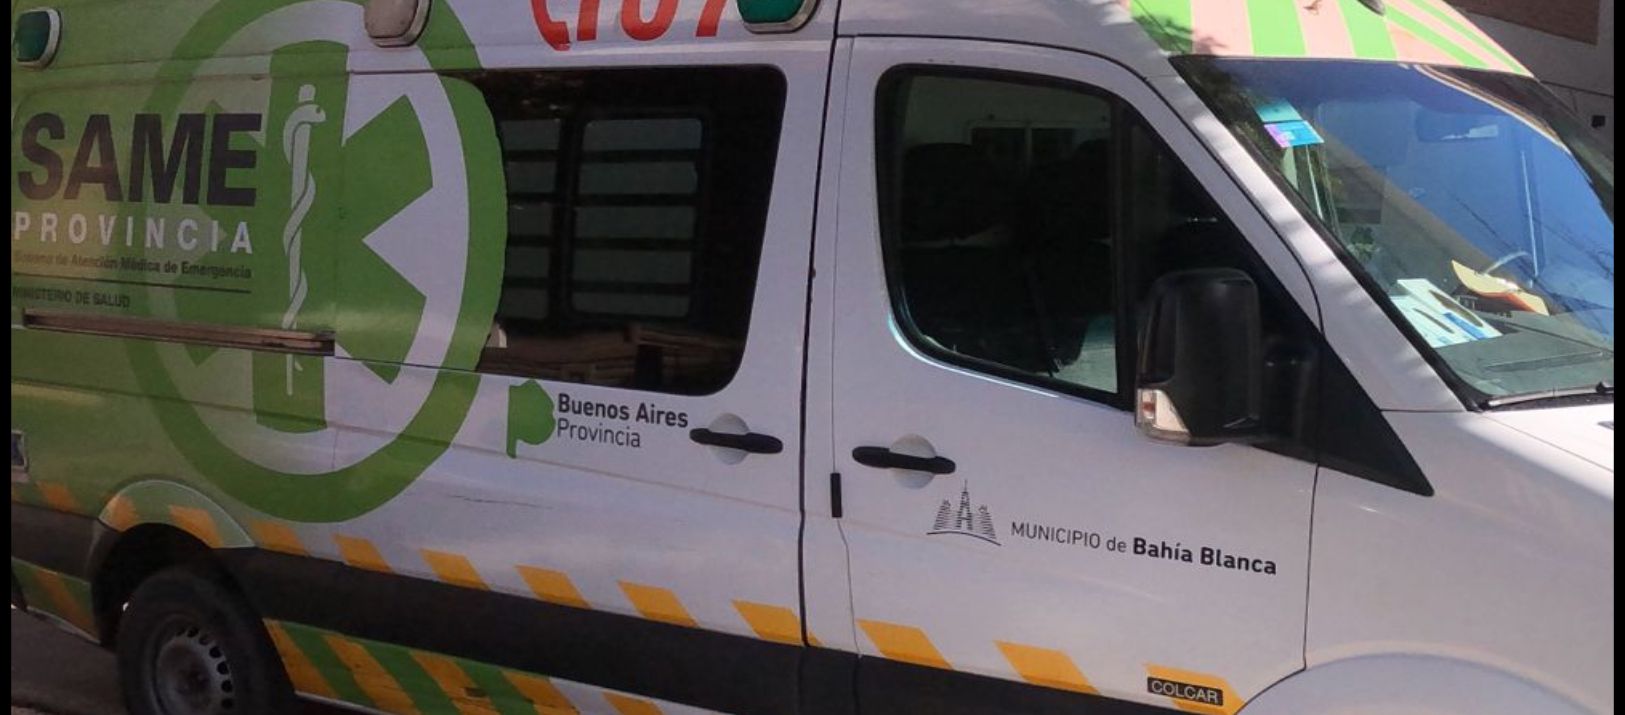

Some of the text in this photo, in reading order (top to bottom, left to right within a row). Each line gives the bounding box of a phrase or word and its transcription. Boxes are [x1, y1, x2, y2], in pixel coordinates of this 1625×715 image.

[18, 112, 262, 207] SAME
[14, 211, 253, 254] PROVINCIA
[164, 260, 177, 274] de
[181, 261, 252, 279] Emergencia
[75, 290, 90, 304] DE
[93, 292, 131, 308] SALUD
[558, 393, 688, 428] Buenos Aires
[557, 418, 641, 448] Provincia
[1011, 521, 1277, 575] MUNICIPIO de Bahía Blanca
[1151, 680, 1219, 704] COLCAR
